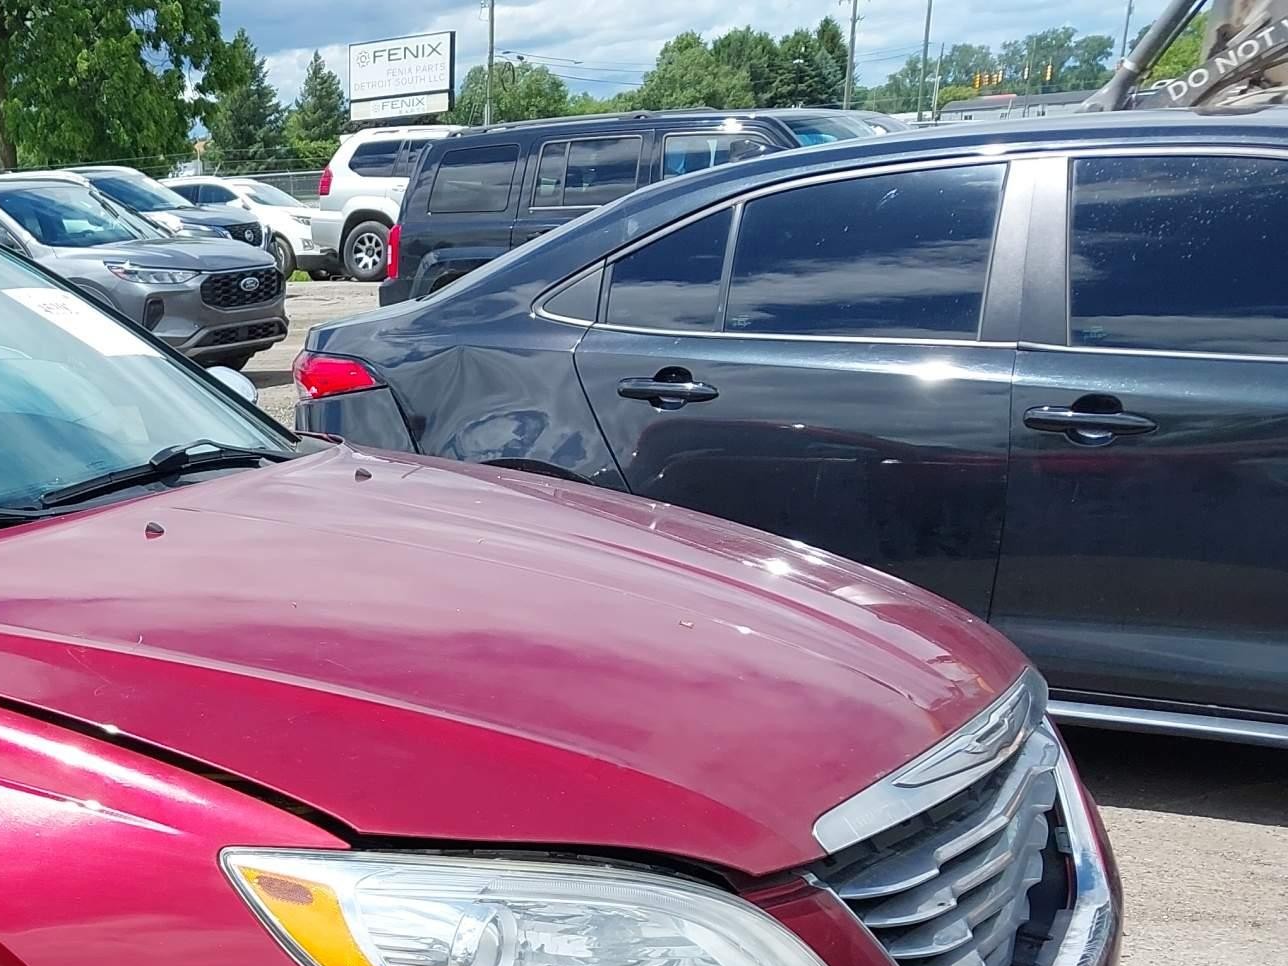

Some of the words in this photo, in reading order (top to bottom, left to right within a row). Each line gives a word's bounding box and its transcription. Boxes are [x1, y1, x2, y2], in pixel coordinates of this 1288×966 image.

[372, 41, 442, 64] FENIX
[386, 67, 413, 77] FENIX
[415, 62, 446, 75] PARTS
[1167, 68, 1209, 101] DO
[1214, 26, 1275, 74] NOT
[353, 78, 392, 92] DETROIT
[393, 75, 426, 87] SOUTH
[428, 73, 445, 83] LLC
[381, 97, 425, 110] FENIX
